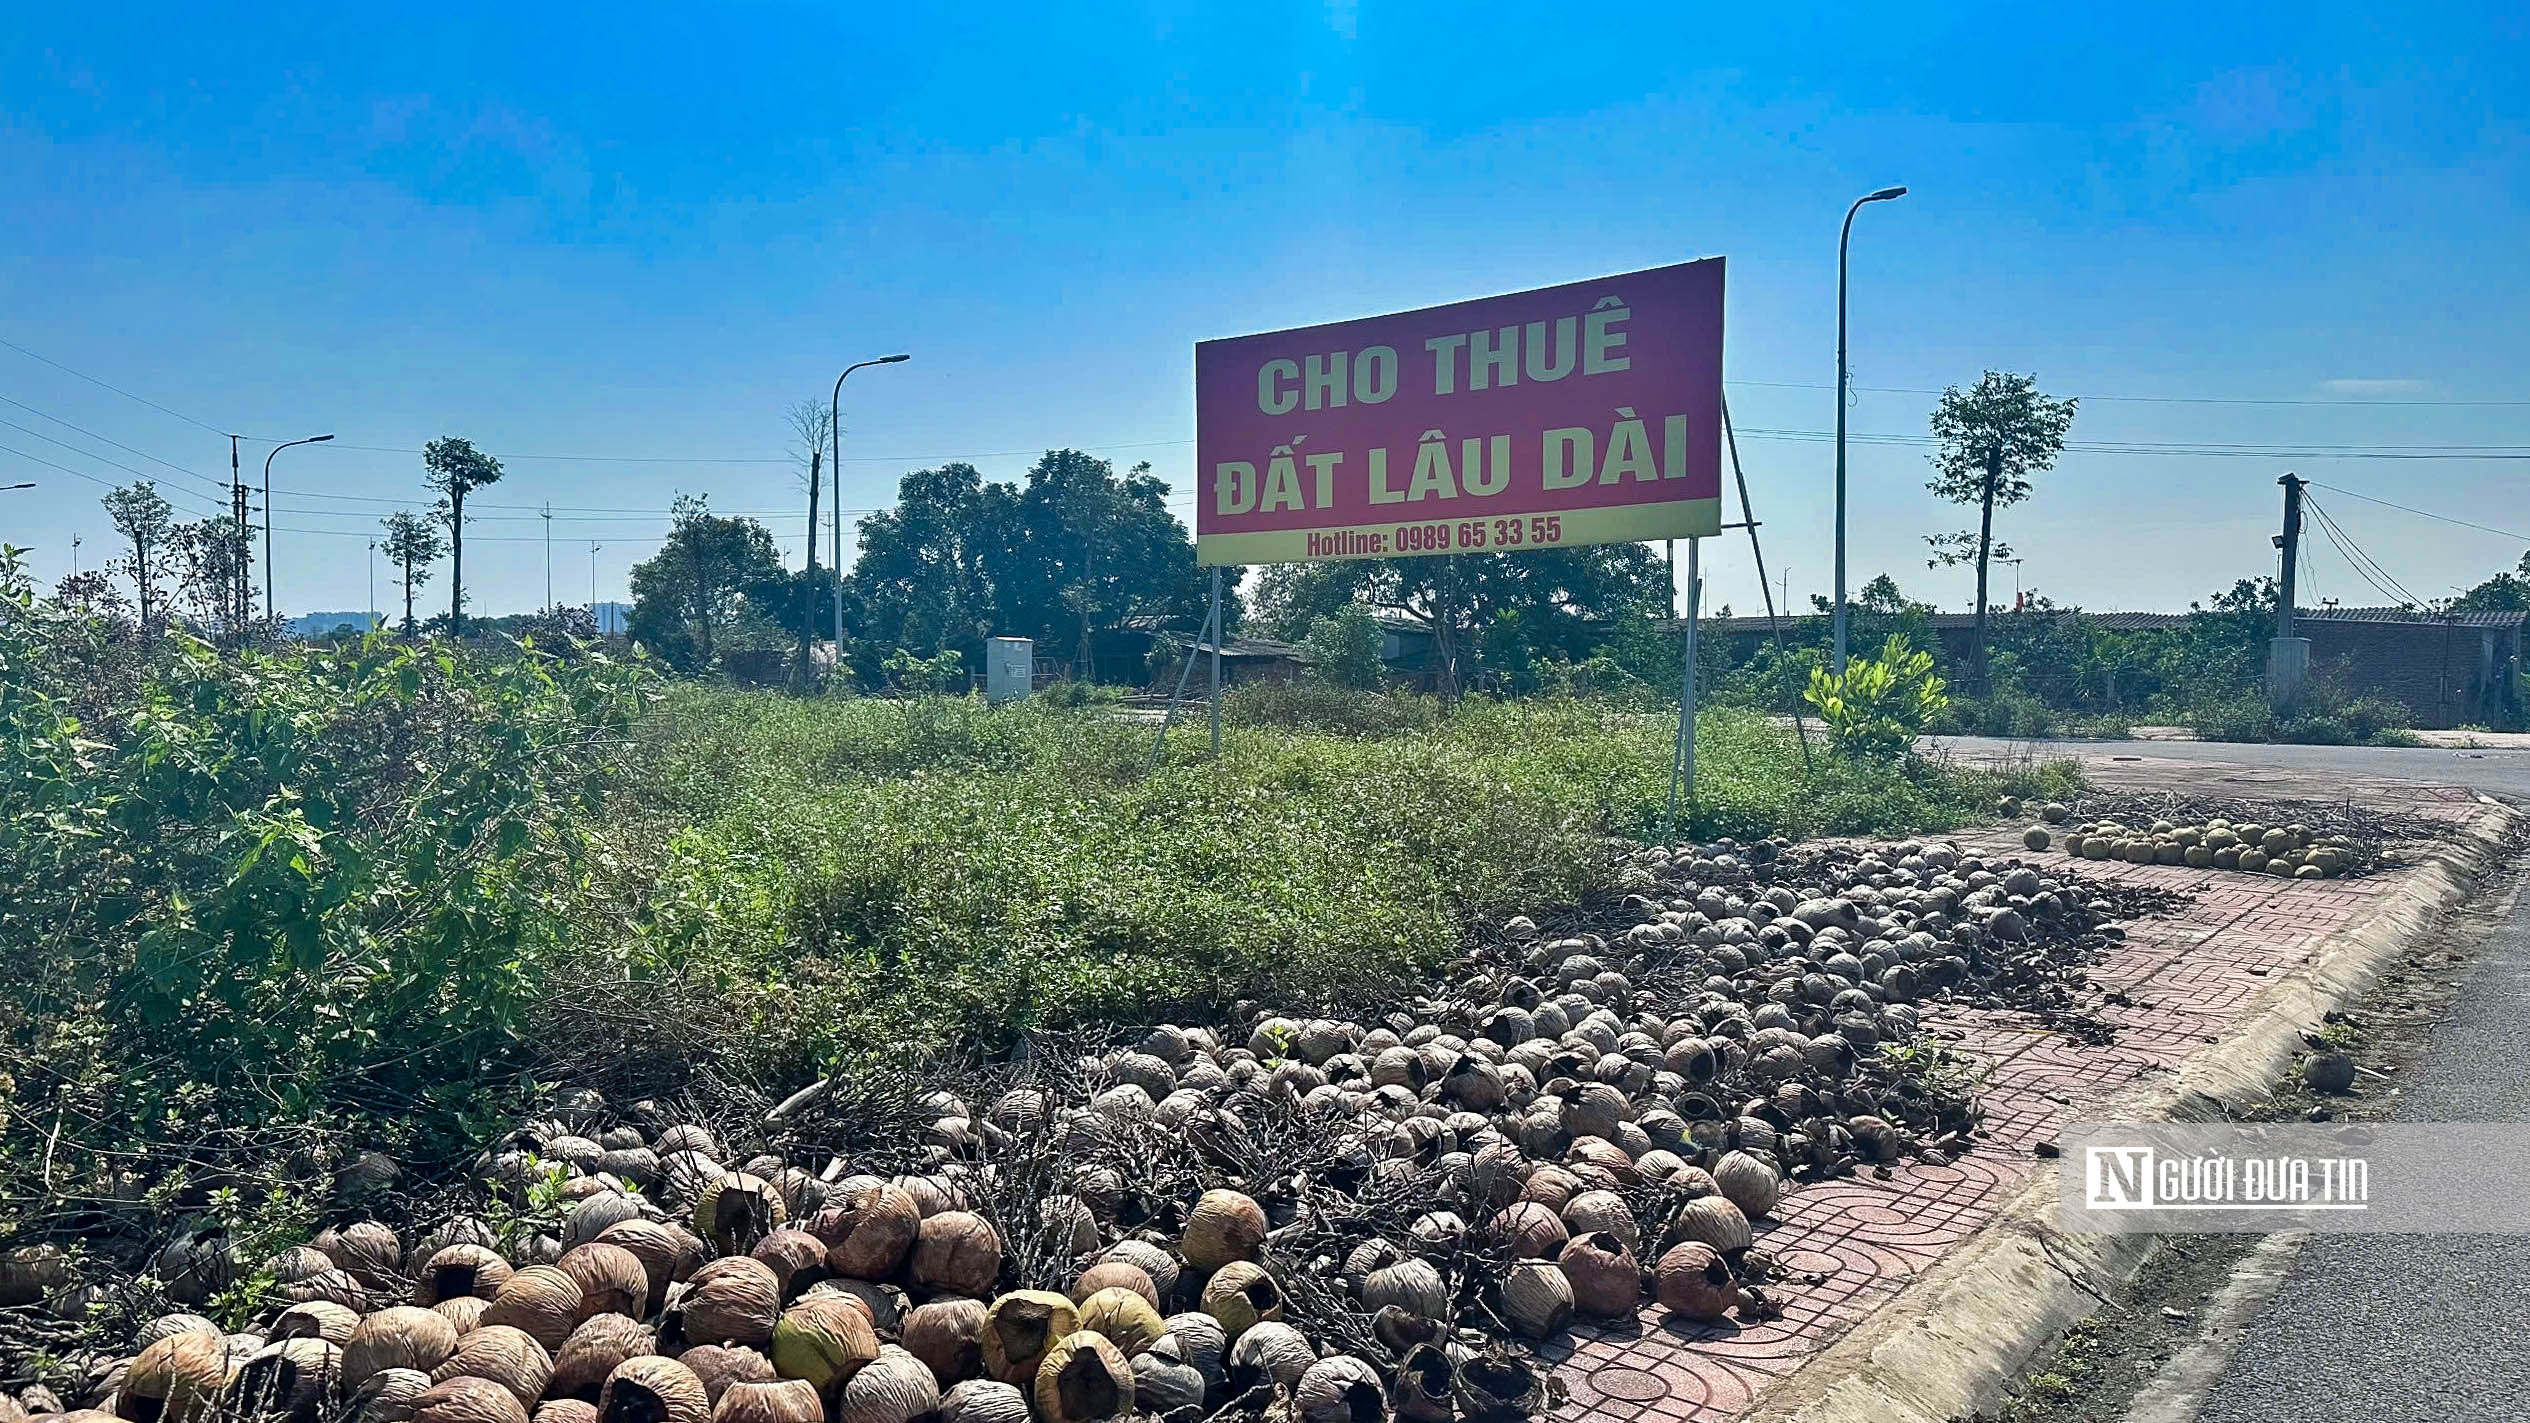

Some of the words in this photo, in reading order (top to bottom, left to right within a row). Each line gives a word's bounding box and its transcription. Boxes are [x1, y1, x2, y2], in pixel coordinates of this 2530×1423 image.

[1257, 345, 1398, 416] CHO
[1425, 295, 1632, 396] THUÊ
[1214, 434, 1344, 516] ĐẤT
[1368, 429, 1511, 505] LÂU
[1542, 406, 1688, 491] DÀI
[1307, 530, 1389, 557] Hotline:
[1395, 524, 1451, 551] 0989
[1458, 521, 1486, 548] 65
[1494, 518, 1523, 546] 33
[1531, 516, 1562, 544] 55
